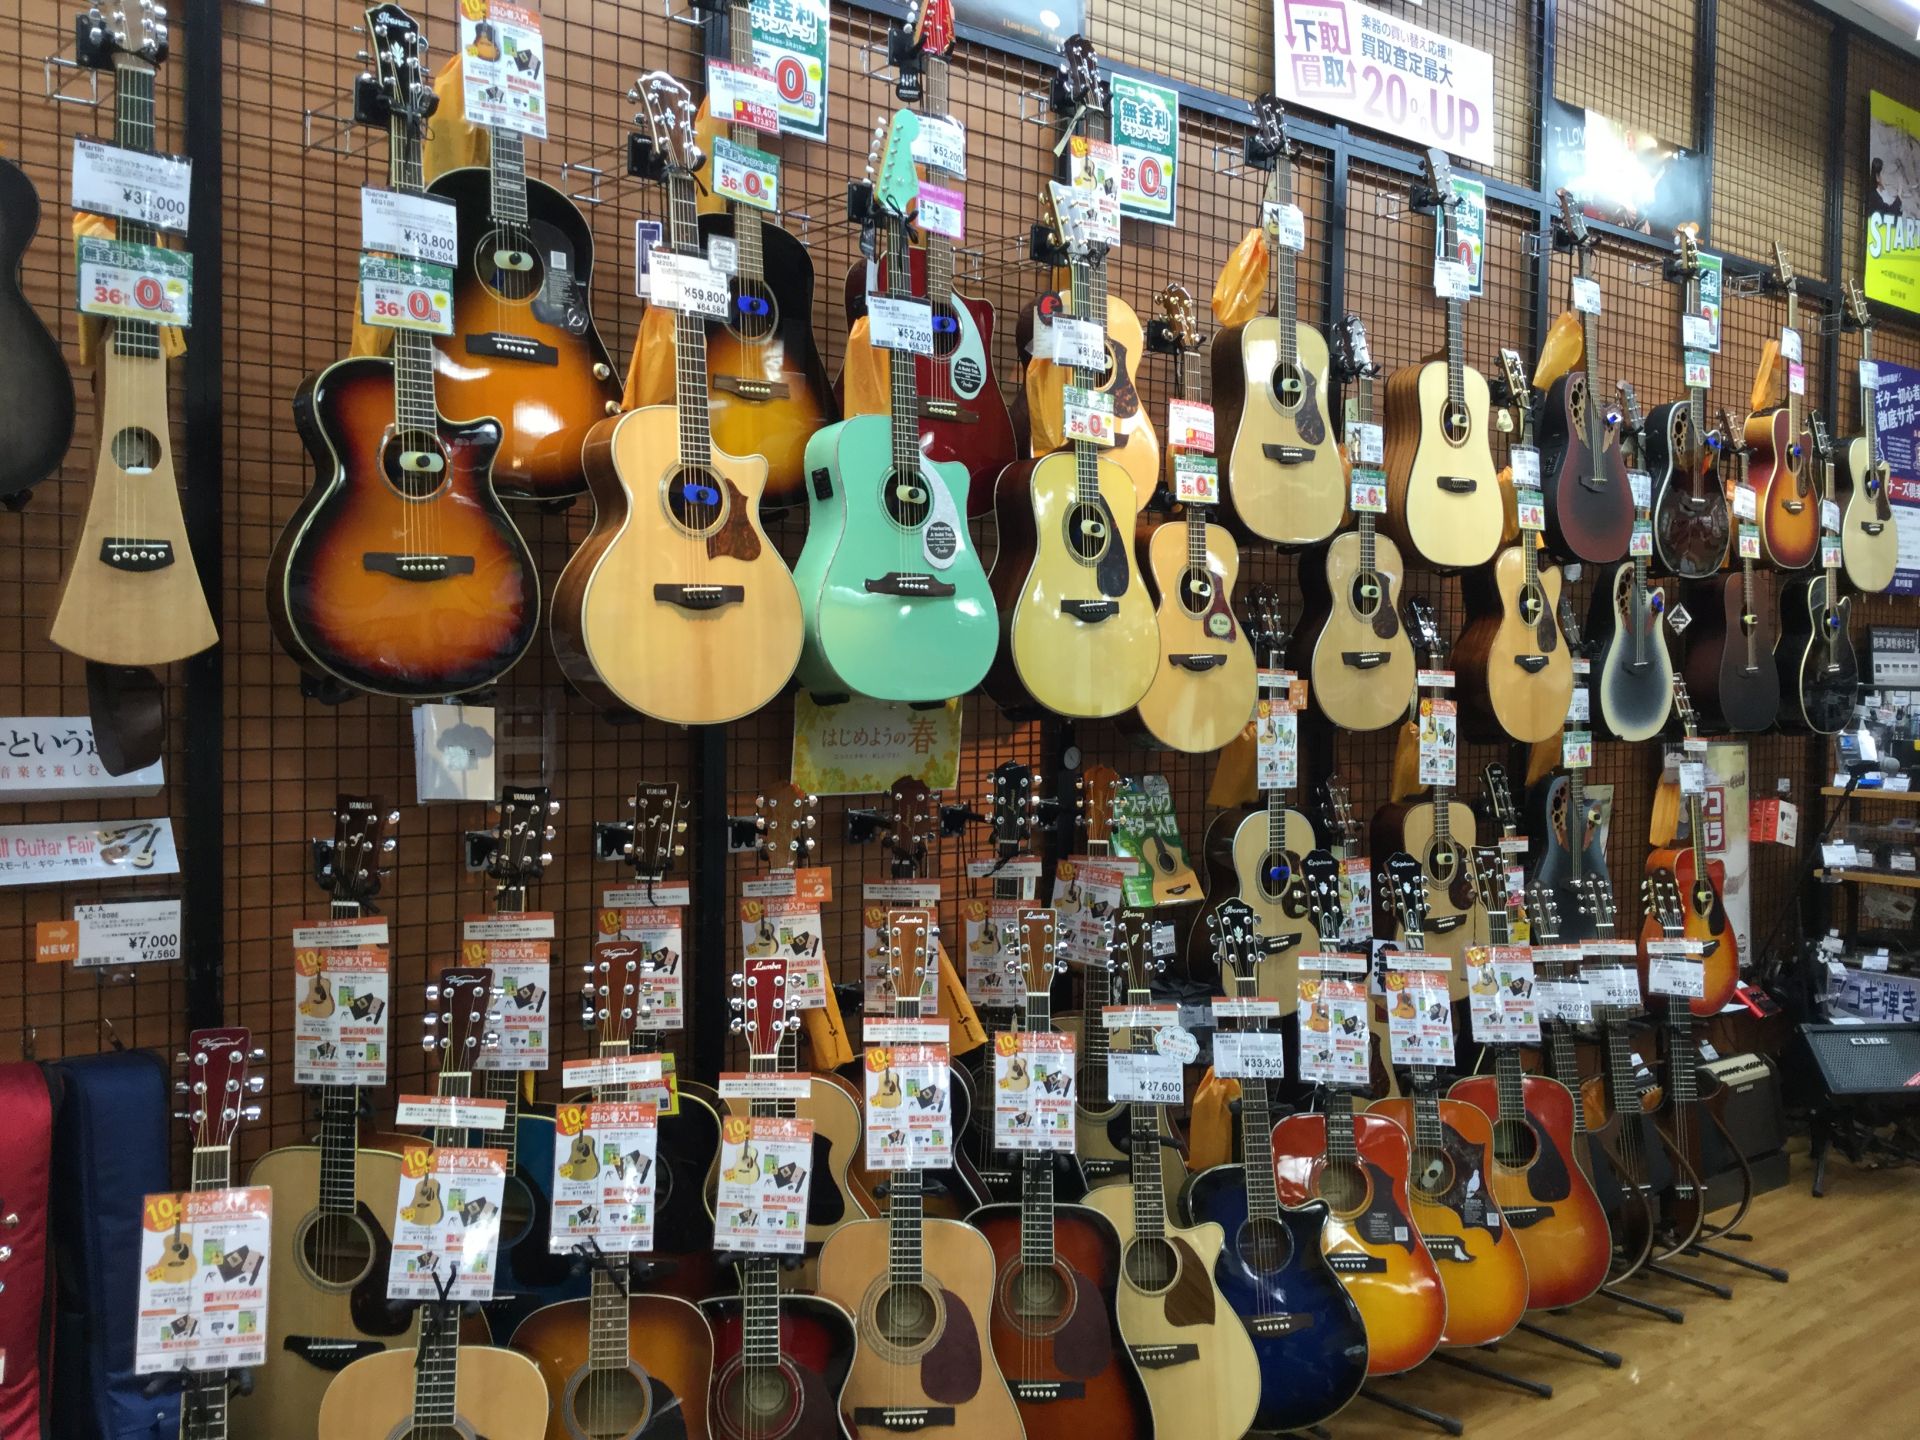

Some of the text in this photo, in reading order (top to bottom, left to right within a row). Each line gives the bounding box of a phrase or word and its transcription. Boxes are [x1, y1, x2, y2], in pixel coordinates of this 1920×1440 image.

[376, 12, 411, 28] Ibanez
[1294, 18, 1346, 54] 下取
[1361, 33, 1453, 88] 買取査定最大
[1299, 54, 1347, 88] 買取
[1121, 101, 1169, 132] 無金利
[1121, 124, 1171, 146] キャンペーン!
[684, 286, 726, 304] ¥59,800
[898, 327, 932, 343] ¥52,200
[822, 716, 938, 755] はじめようの春
[513, 793, 536, 801] YAMAHA
[15, 834, 96, 858] Guitar Fair
[1307, 859, 1333, 867] Epiphone
[1391, 859, 1416, 867] Epiphone
[1121, 908, 1146, 921] Ibanez
[1222, 906, 1249, 916] Ibanez
[129, 934, 177, 949] ¥7,000
[40, 943, 76, 956] NEW!
[142, 949, 176, 960] ¥7,560
[1850, 1037, 1890, 1045] CUBE
[1139, 1081, 1181, 1093] ¥27,600
